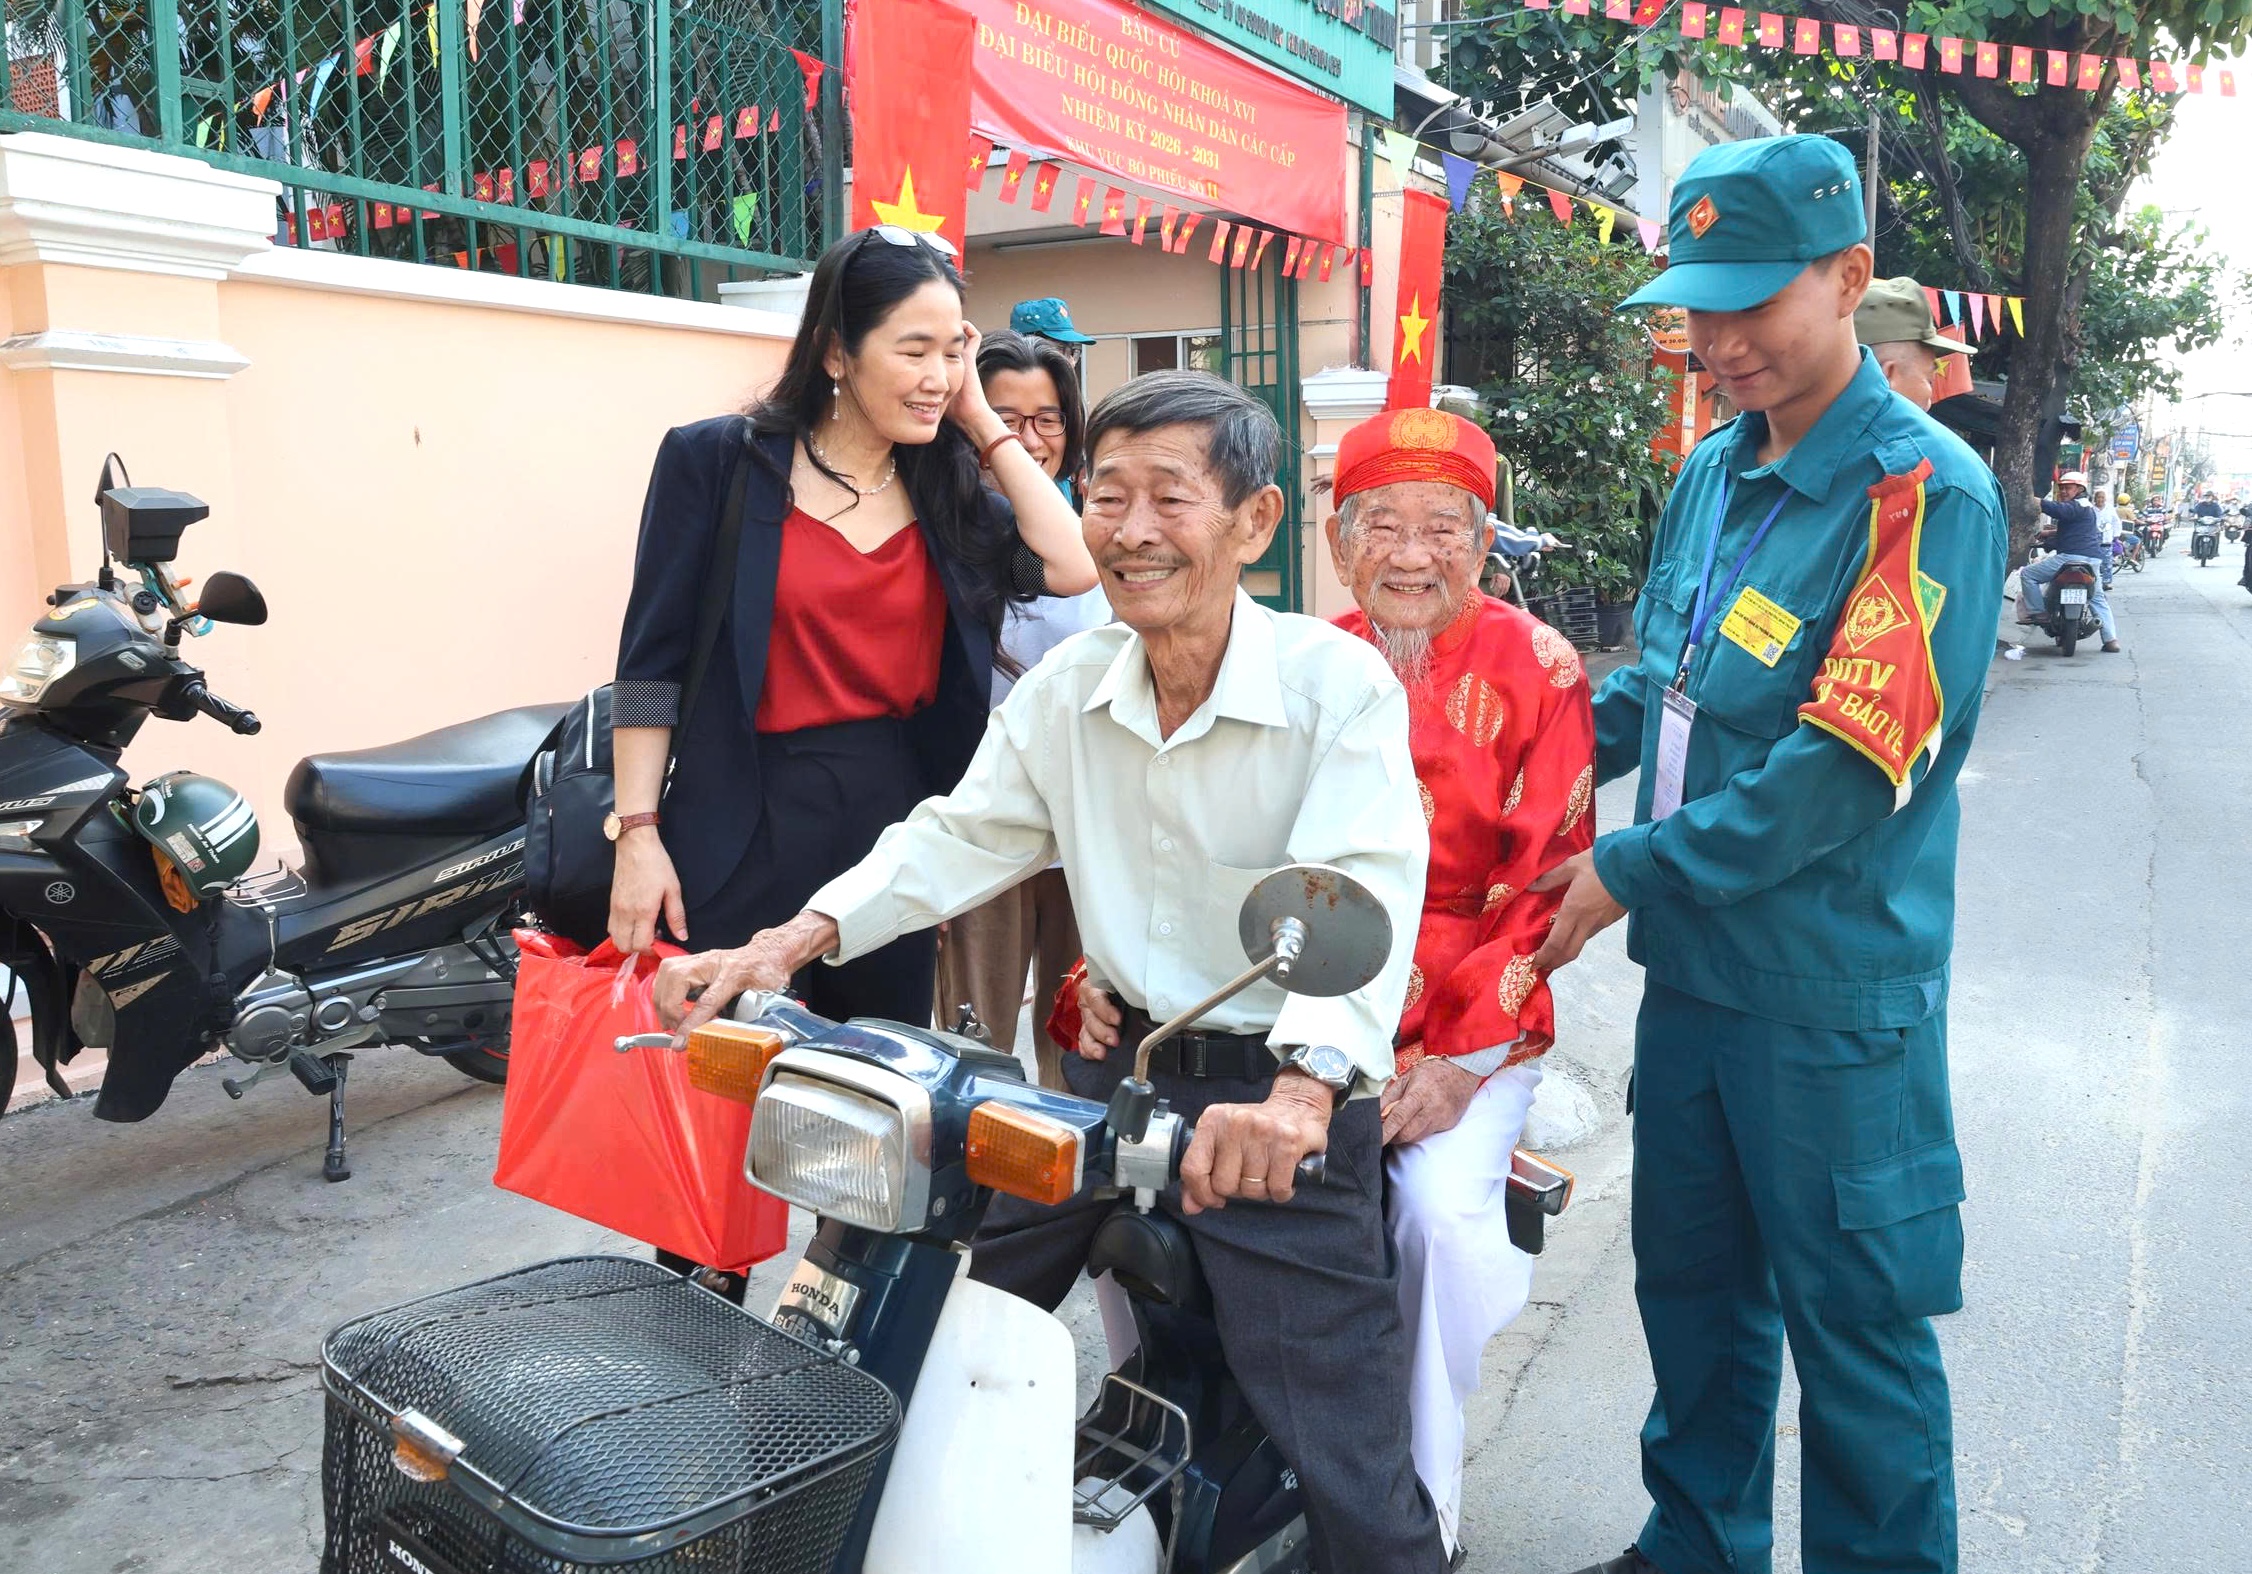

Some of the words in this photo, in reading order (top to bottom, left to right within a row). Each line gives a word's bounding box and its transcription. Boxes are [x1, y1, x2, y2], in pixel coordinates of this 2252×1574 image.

[1016, 2, 1052, 37] ĐẠI
[1057, 19, 1101, 57] BIỂU
[1106, 43, 1154, 79] QUỐC
[1157, 65, 1187, 96] HỘI
[1190, 79, 1230, 113] KHOÁ
[1233, 99, 1256, 124] XVI
[1121, 13, 1154, 46] BẦU
[1159, 31, 1181, 58] CỬ
[979, 23, 1016, 59] ĐẠI
[1021, 41, 1068, 78] BIỂU
[1074, 63, 1107, 96] HỘI
[1111, 76, 1158, 115] ĐỒNG
[1162, 100, 1206, 134] NHÂN
[1209, 119, 1239, 146] DÂN
[1241, 132, 1267, 158] CÁC
[1270, 142, 1295, 168] CẤP
[1061, 94, 1120, 134] NHIỆM
[1125, 117, 1147, 143] KỲ
[1150, 130, 1181, 156] 2026
[1192, 145, 1220, 170] 2031
[791, 1283, 839, 1317] HONDA
